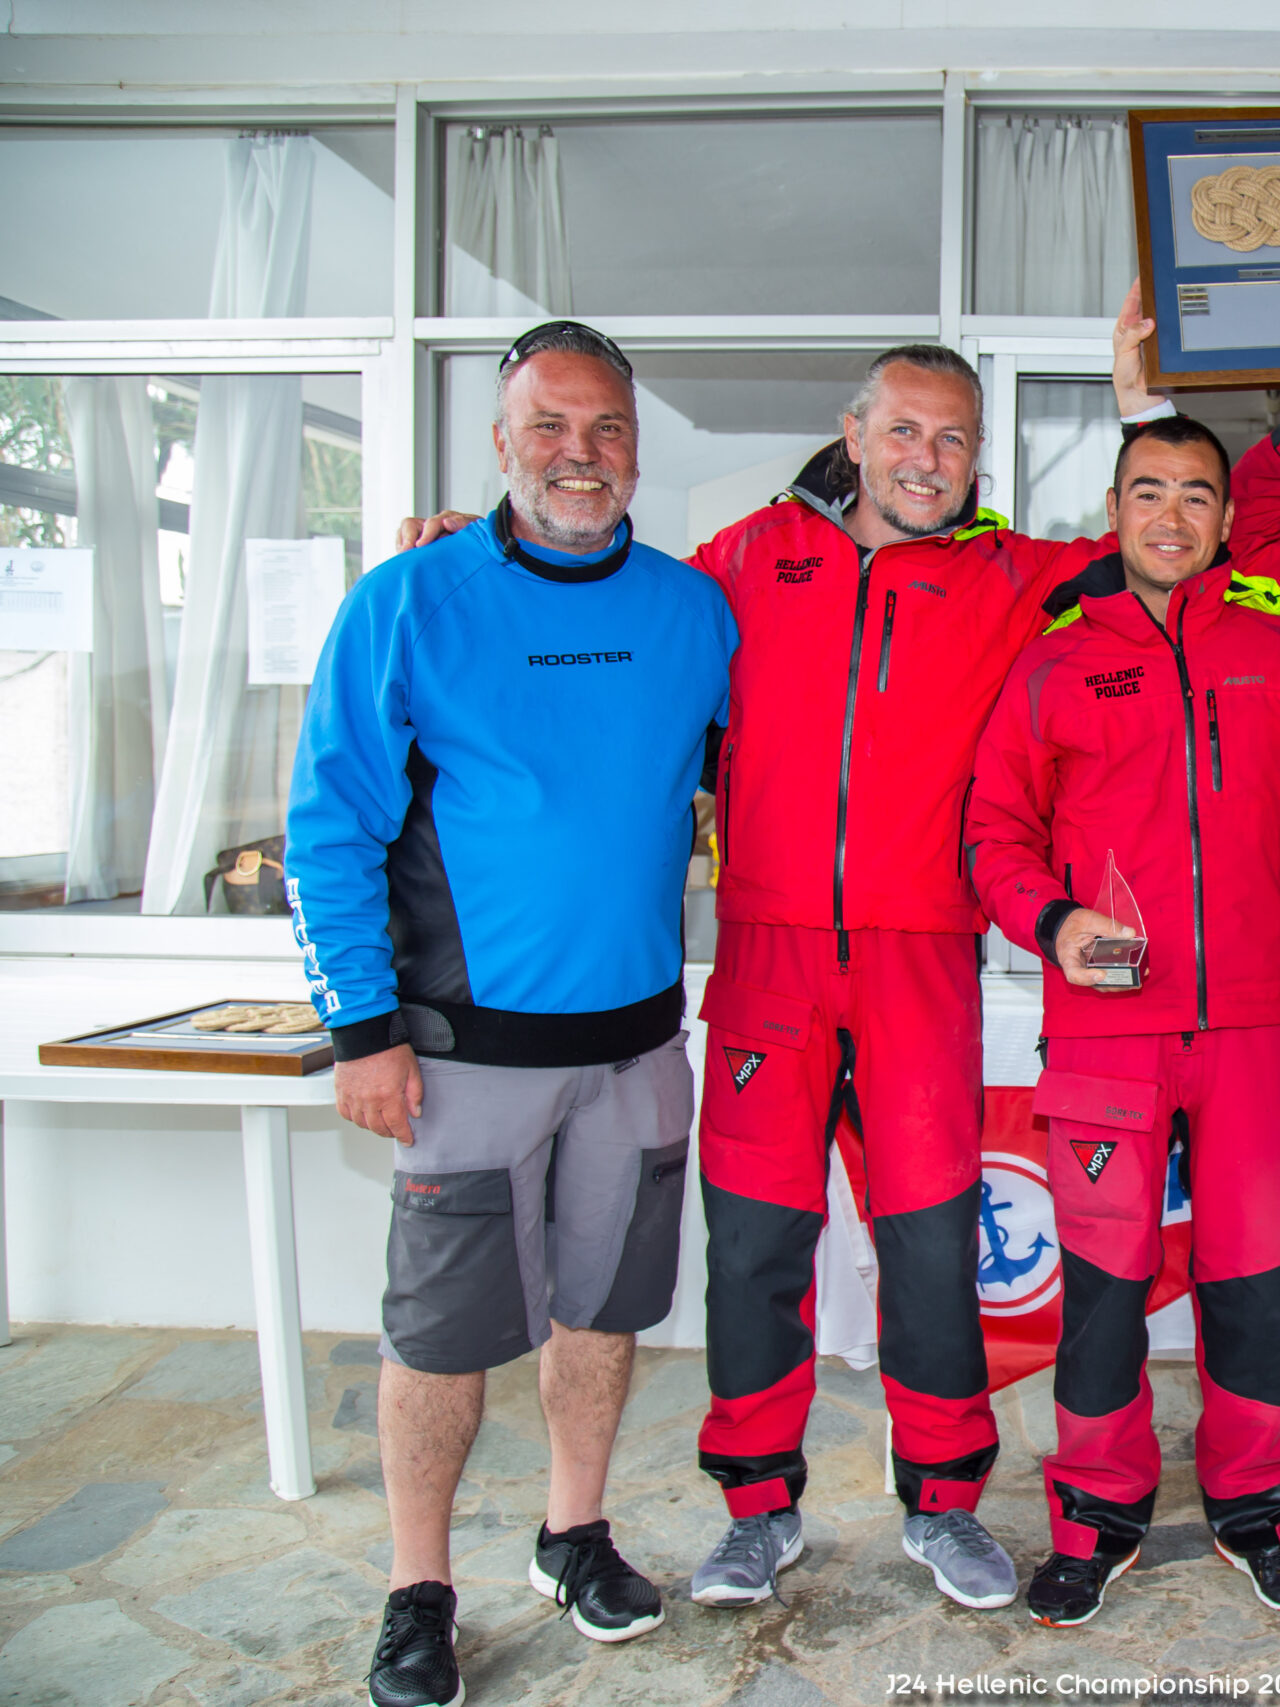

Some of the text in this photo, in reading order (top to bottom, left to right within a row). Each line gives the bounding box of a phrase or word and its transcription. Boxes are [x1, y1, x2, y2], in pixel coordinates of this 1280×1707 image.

[908, 580, 947, 598] MUSTO
[527, 651, 633, 667] ROOSTER
[1084, 666, 1145, 688] HELLENIC
[1222, 675, 1266, 686] MUSTO
[1095, 681, 1141, 699] POLICE
[735, 1053, 761, 1085] MPX
[1087, 1143, 1112, 1176] MPX
